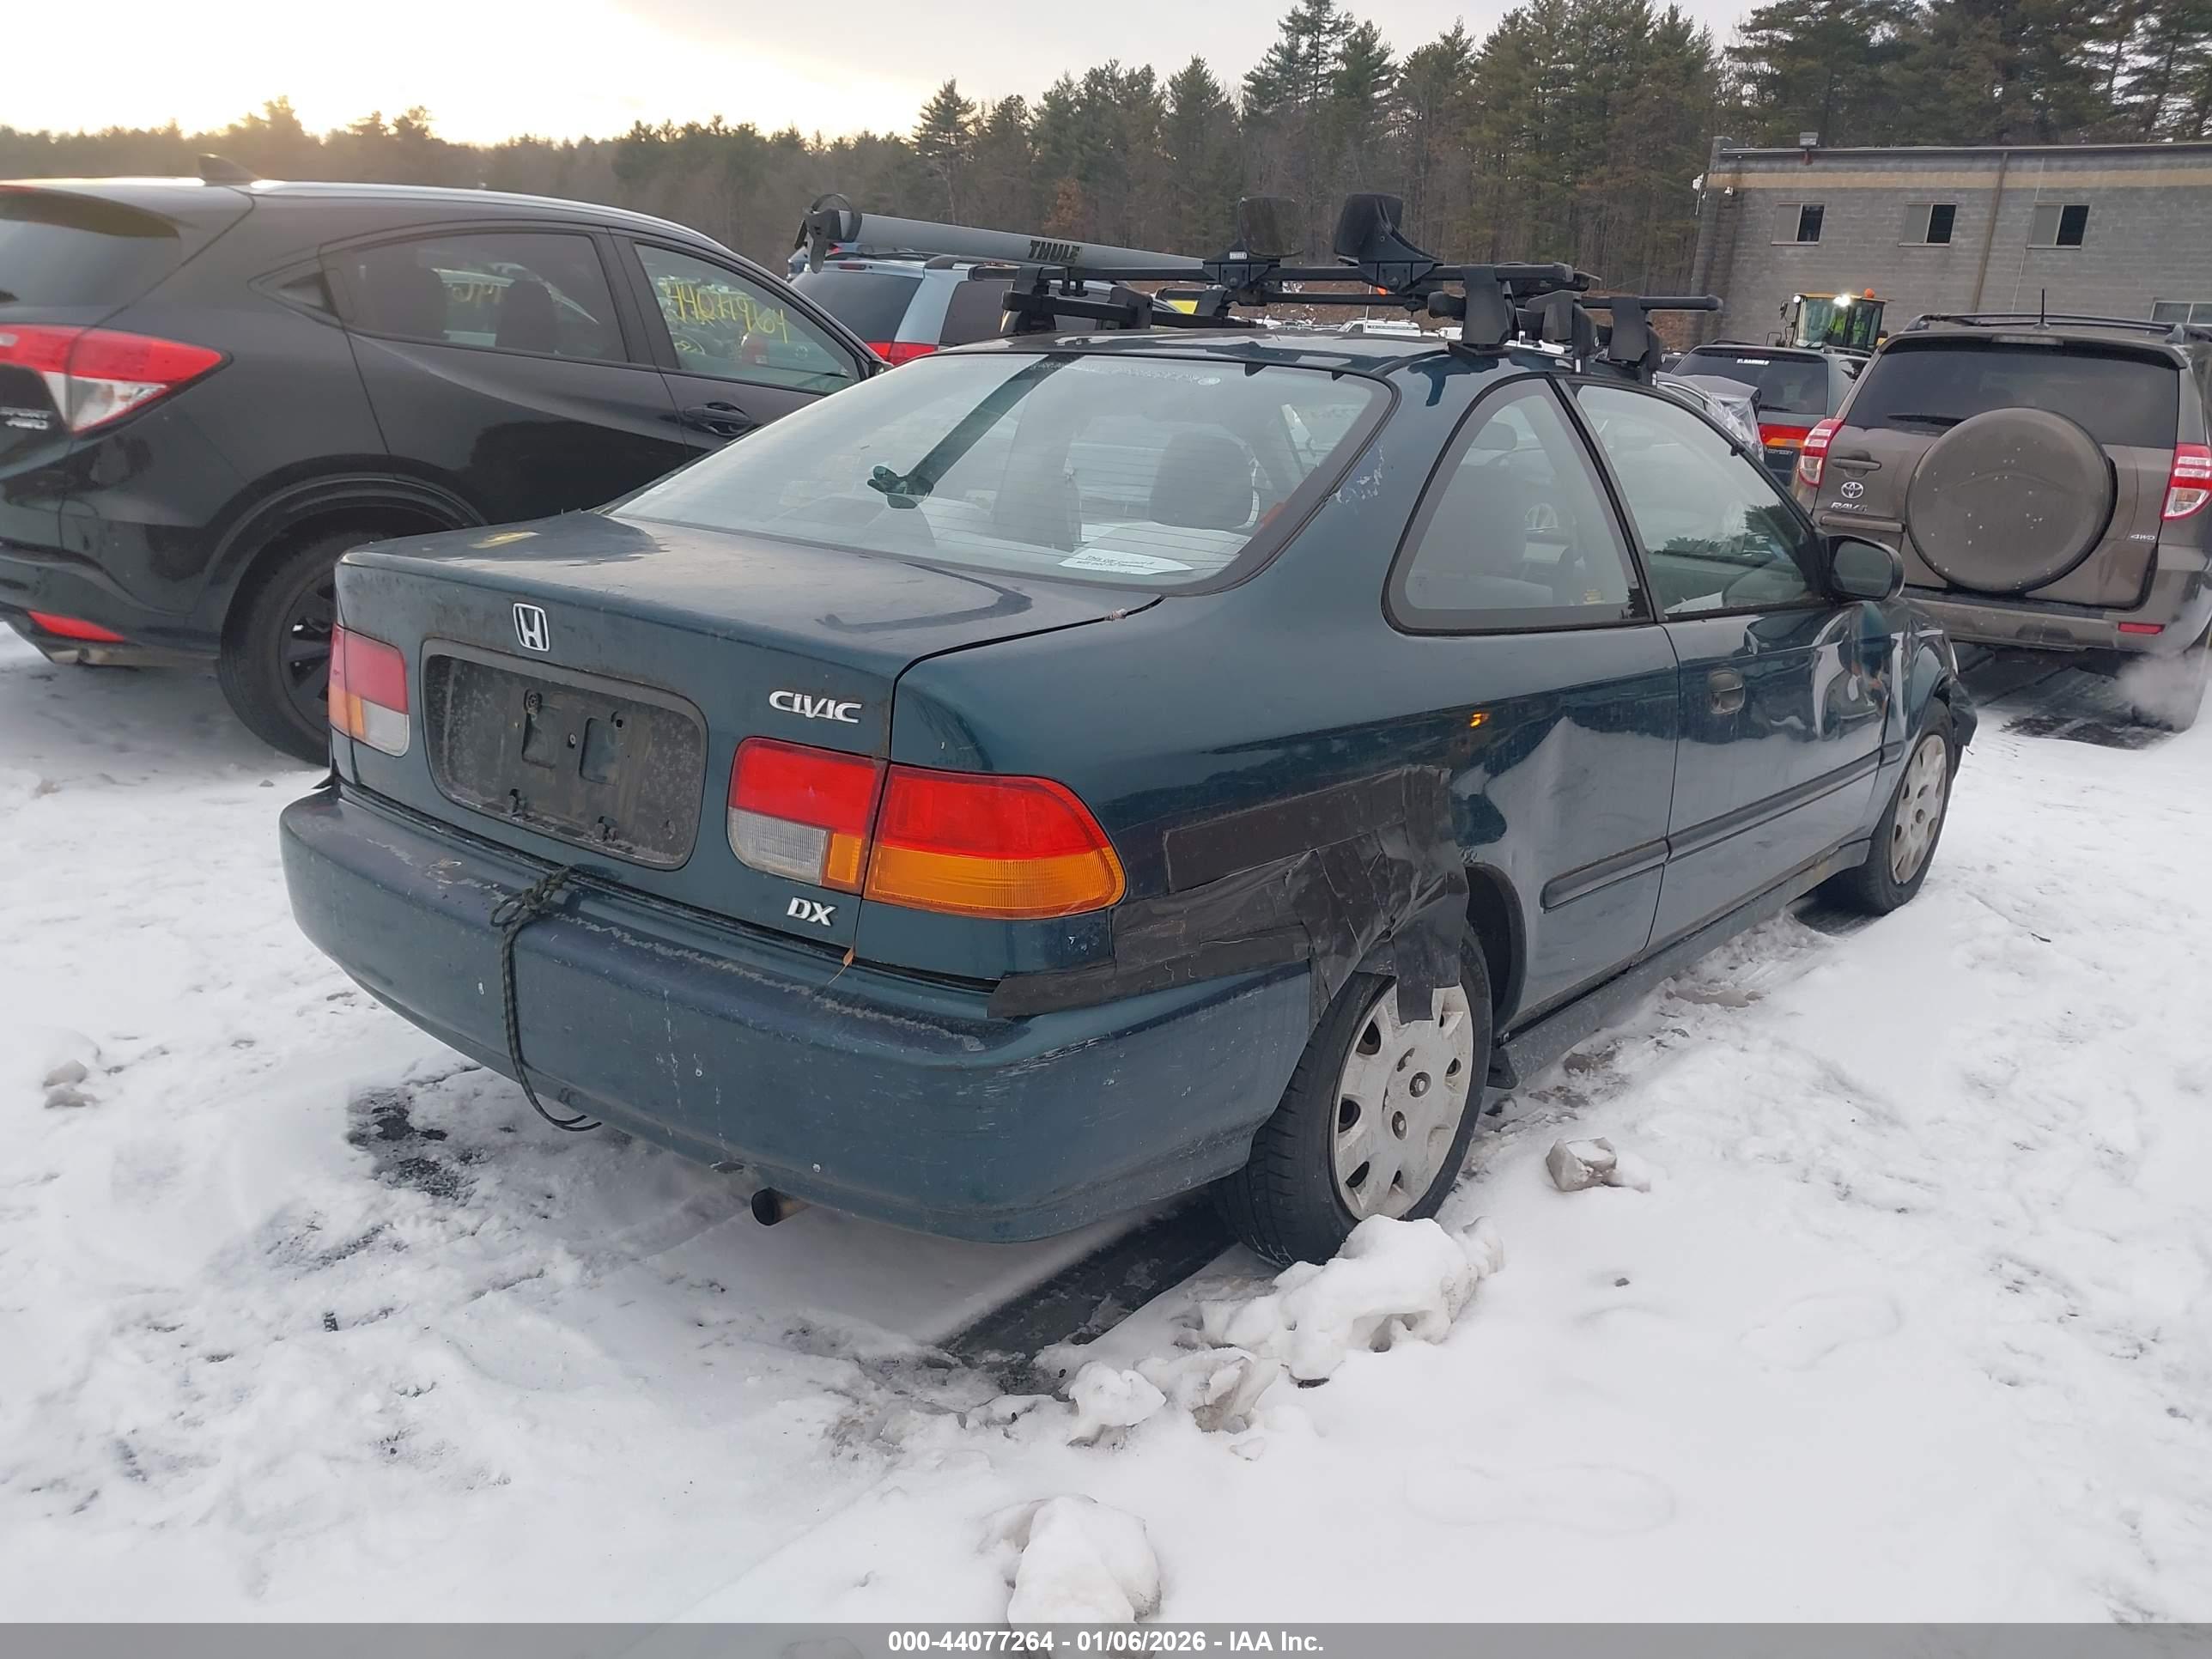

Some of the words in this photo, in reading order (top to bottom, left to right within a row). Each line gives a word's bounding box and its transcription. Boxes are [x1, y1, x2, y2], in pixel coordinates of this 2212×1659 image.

[1028, 240, 1082, 264] THULE
[769, 690, 863, 724] CIVIC
[787, 896, 836, 927] DX
